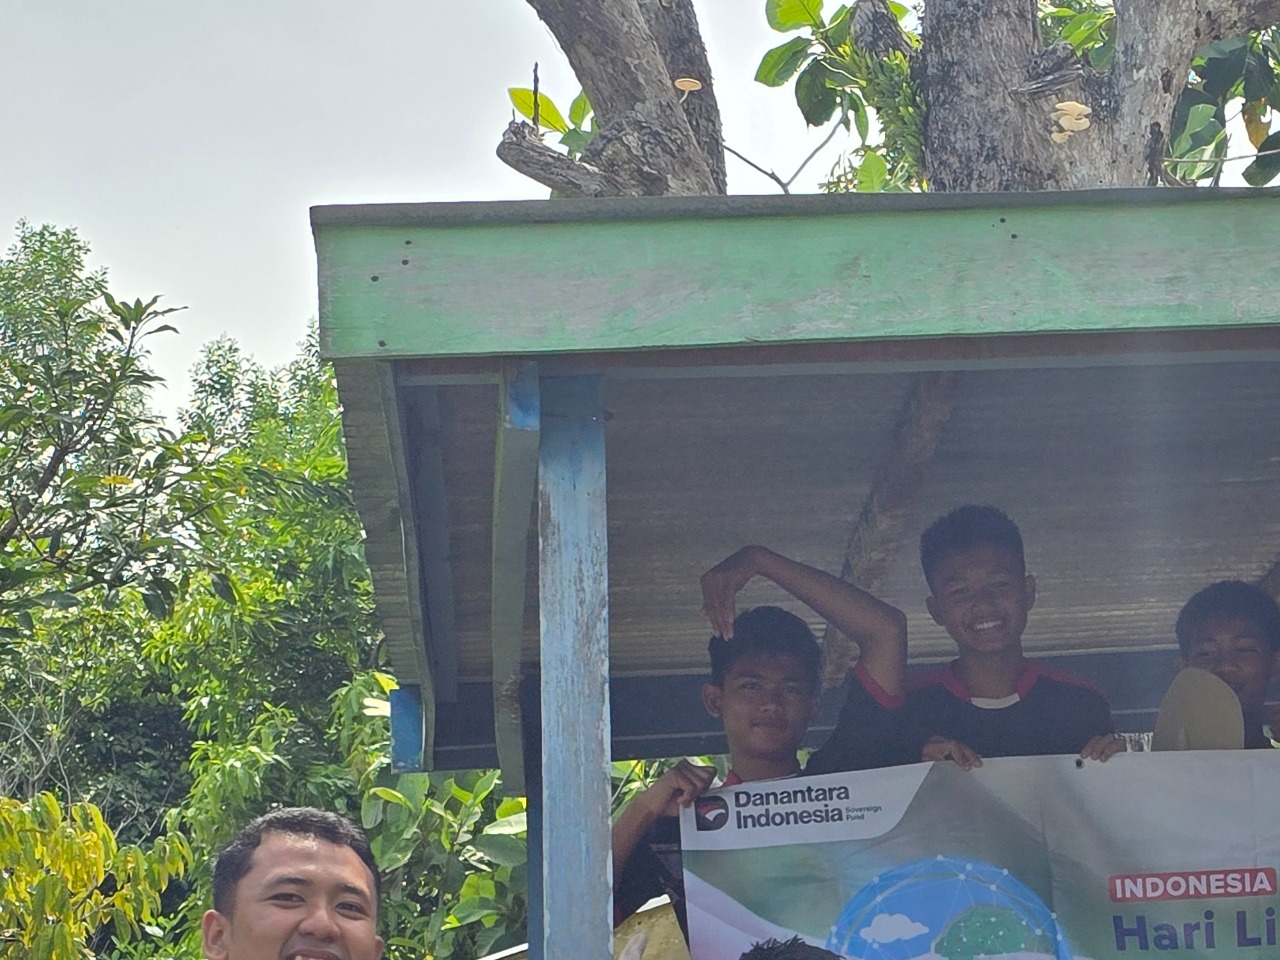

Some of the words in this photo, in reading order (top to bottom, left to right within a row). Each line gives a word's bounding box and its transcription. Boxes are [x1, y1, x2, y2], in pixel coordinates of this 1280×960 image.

[734, 785, 850, 808] Danantara
[736, 804, 843, 829] Indonesia
[1115, 872, 1272, 899] INDONESIA
[1112, 910, 1216, 951] Hari
